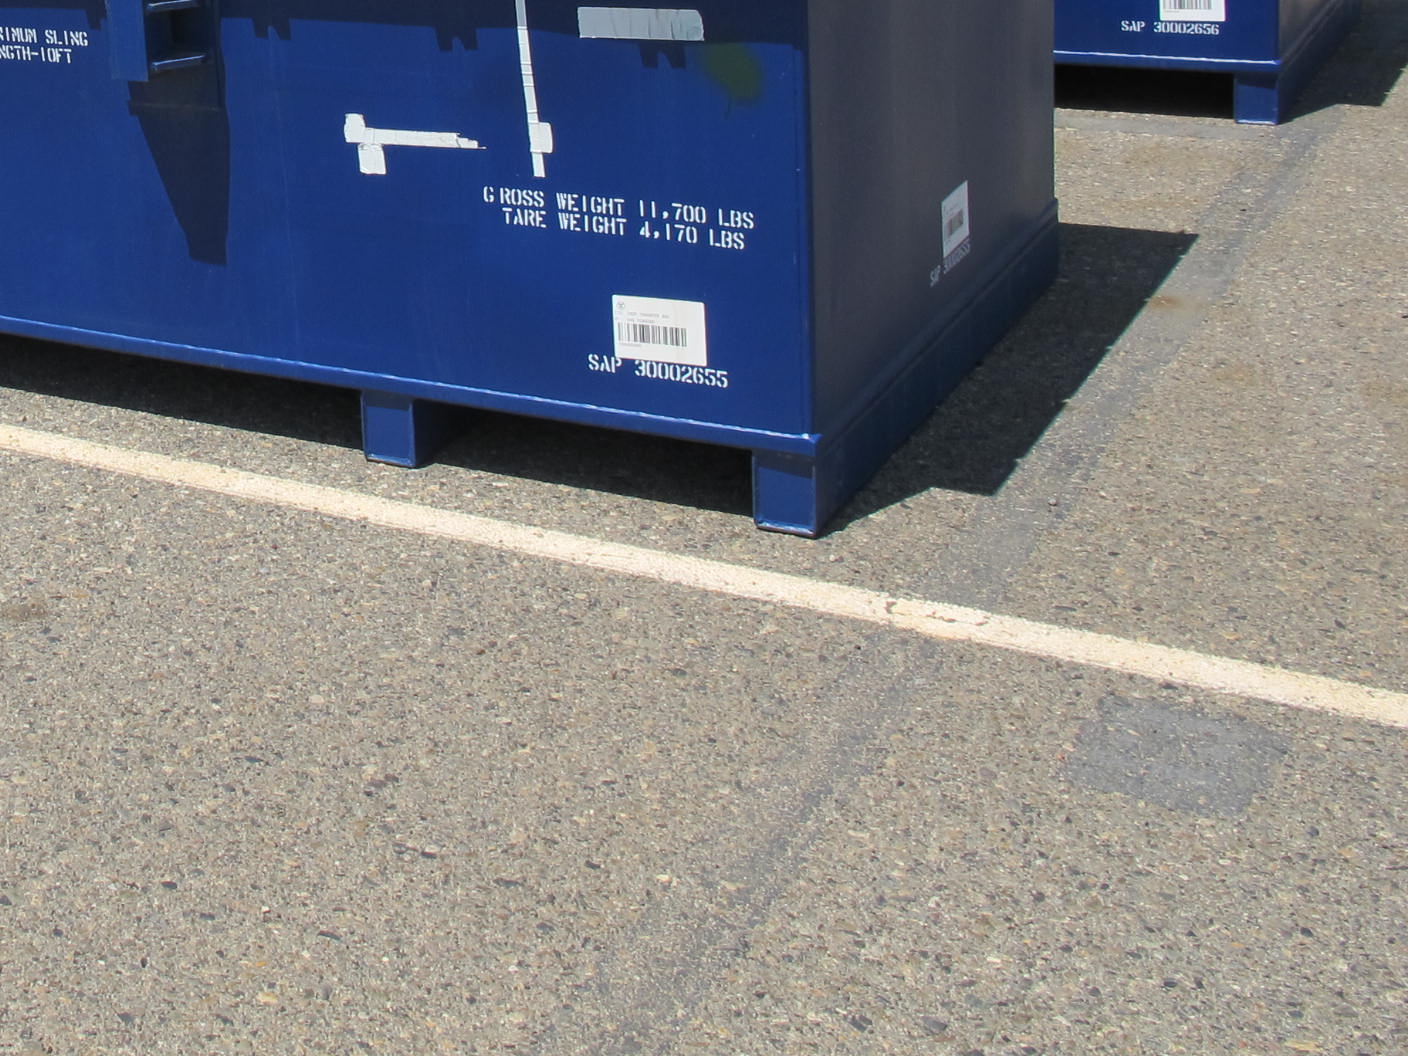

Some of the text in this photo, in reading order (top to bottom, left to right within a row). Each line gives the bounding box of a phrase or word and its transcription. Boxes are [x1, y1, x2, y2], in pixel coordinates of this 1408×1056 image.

[44, 29, 89, 47] SLING
[1120, 20, 1220, 35] SAP 30002656
[502, 207, 745, 250] TARE WEIGHT 4,170 LBS
[556, 192, 625, 217] WEIGHT
[639, 199, 707, 224] 11,700
[718, 208, 755, 230] LBS
[588, 353, 729, 389] SAP 30002655
